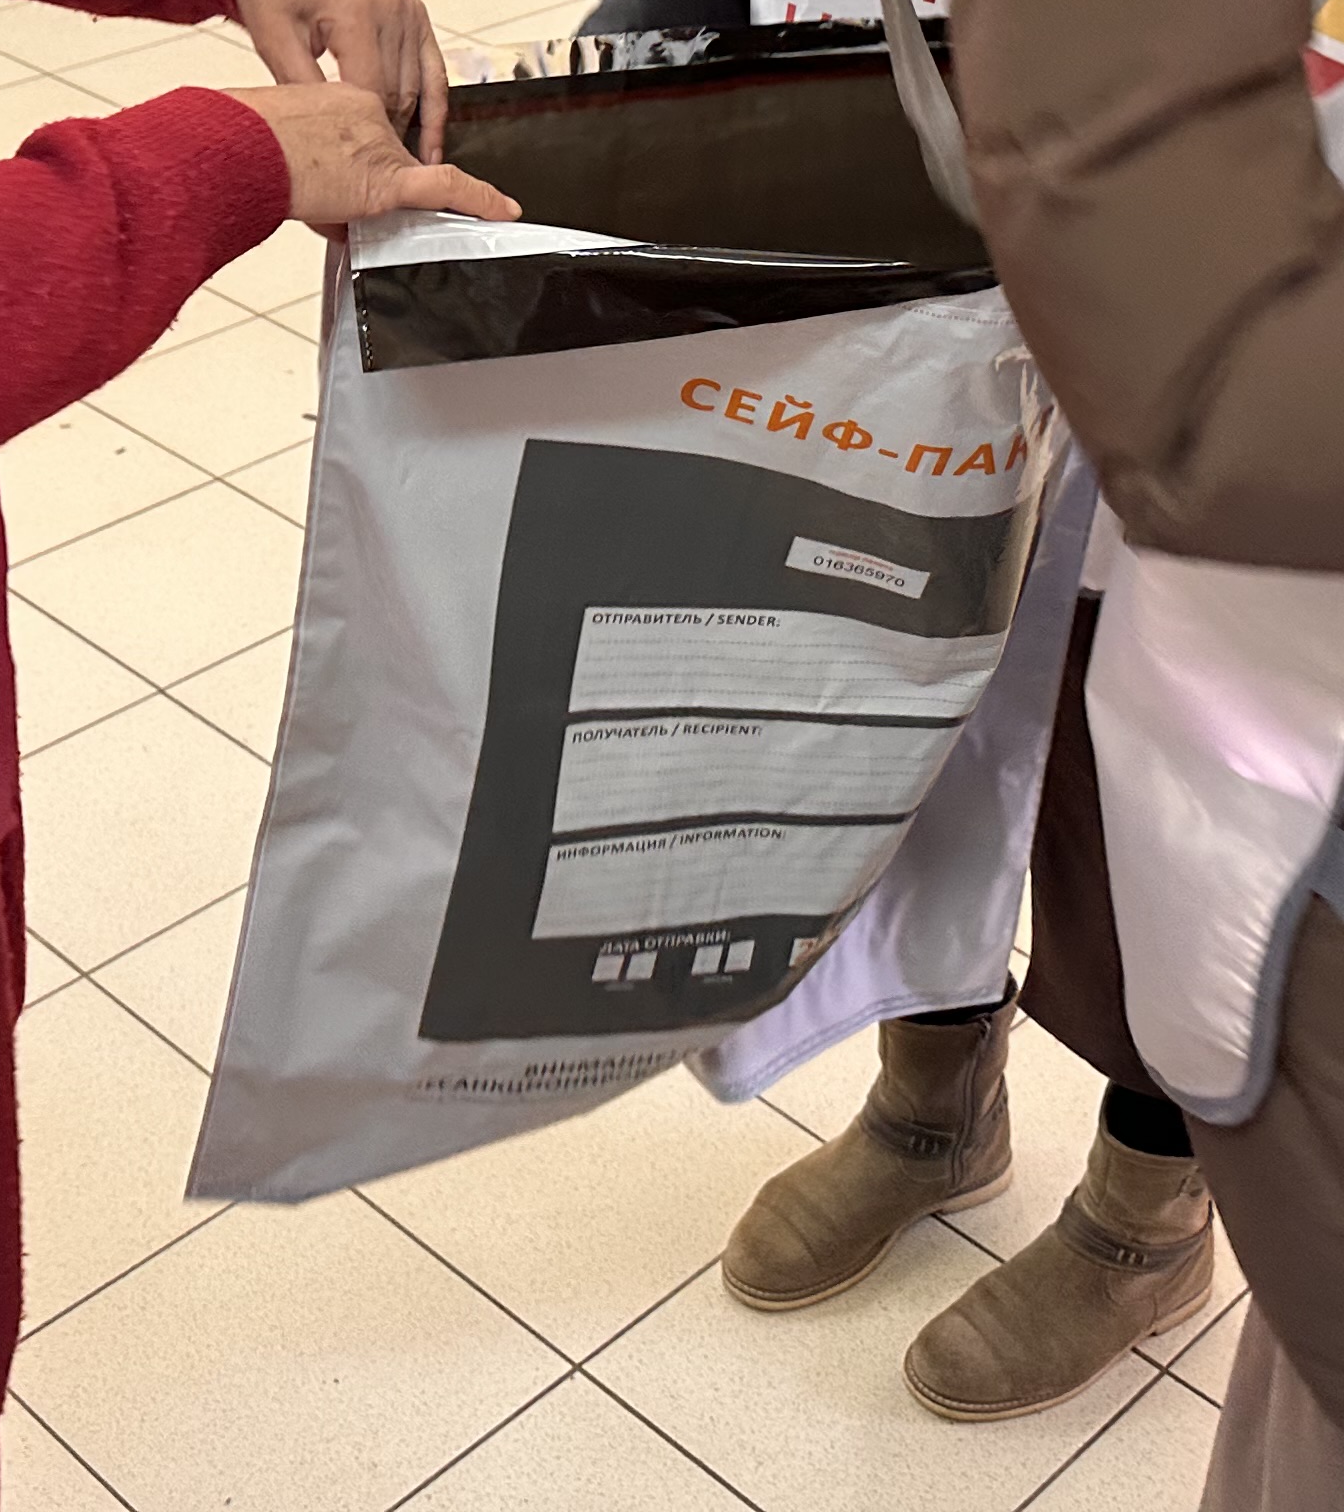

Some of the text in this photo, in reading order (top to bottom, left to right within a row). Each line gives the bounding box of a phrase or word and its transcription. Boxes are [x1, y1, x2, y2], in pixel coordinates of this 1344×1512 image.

[813, 555, 905, 588] 016365970
[592, 613, 702, 625] ОТПРАВИТЕЛЬ
[717, 614, 781, 628] SENDER:
[572, 724, 668, 744] ПОЛУЧАТЕЛЬ
[557, 838, 666, 861] ИНФОРМАЦИЯ
[600, 939, 640, 954] ДАТА
